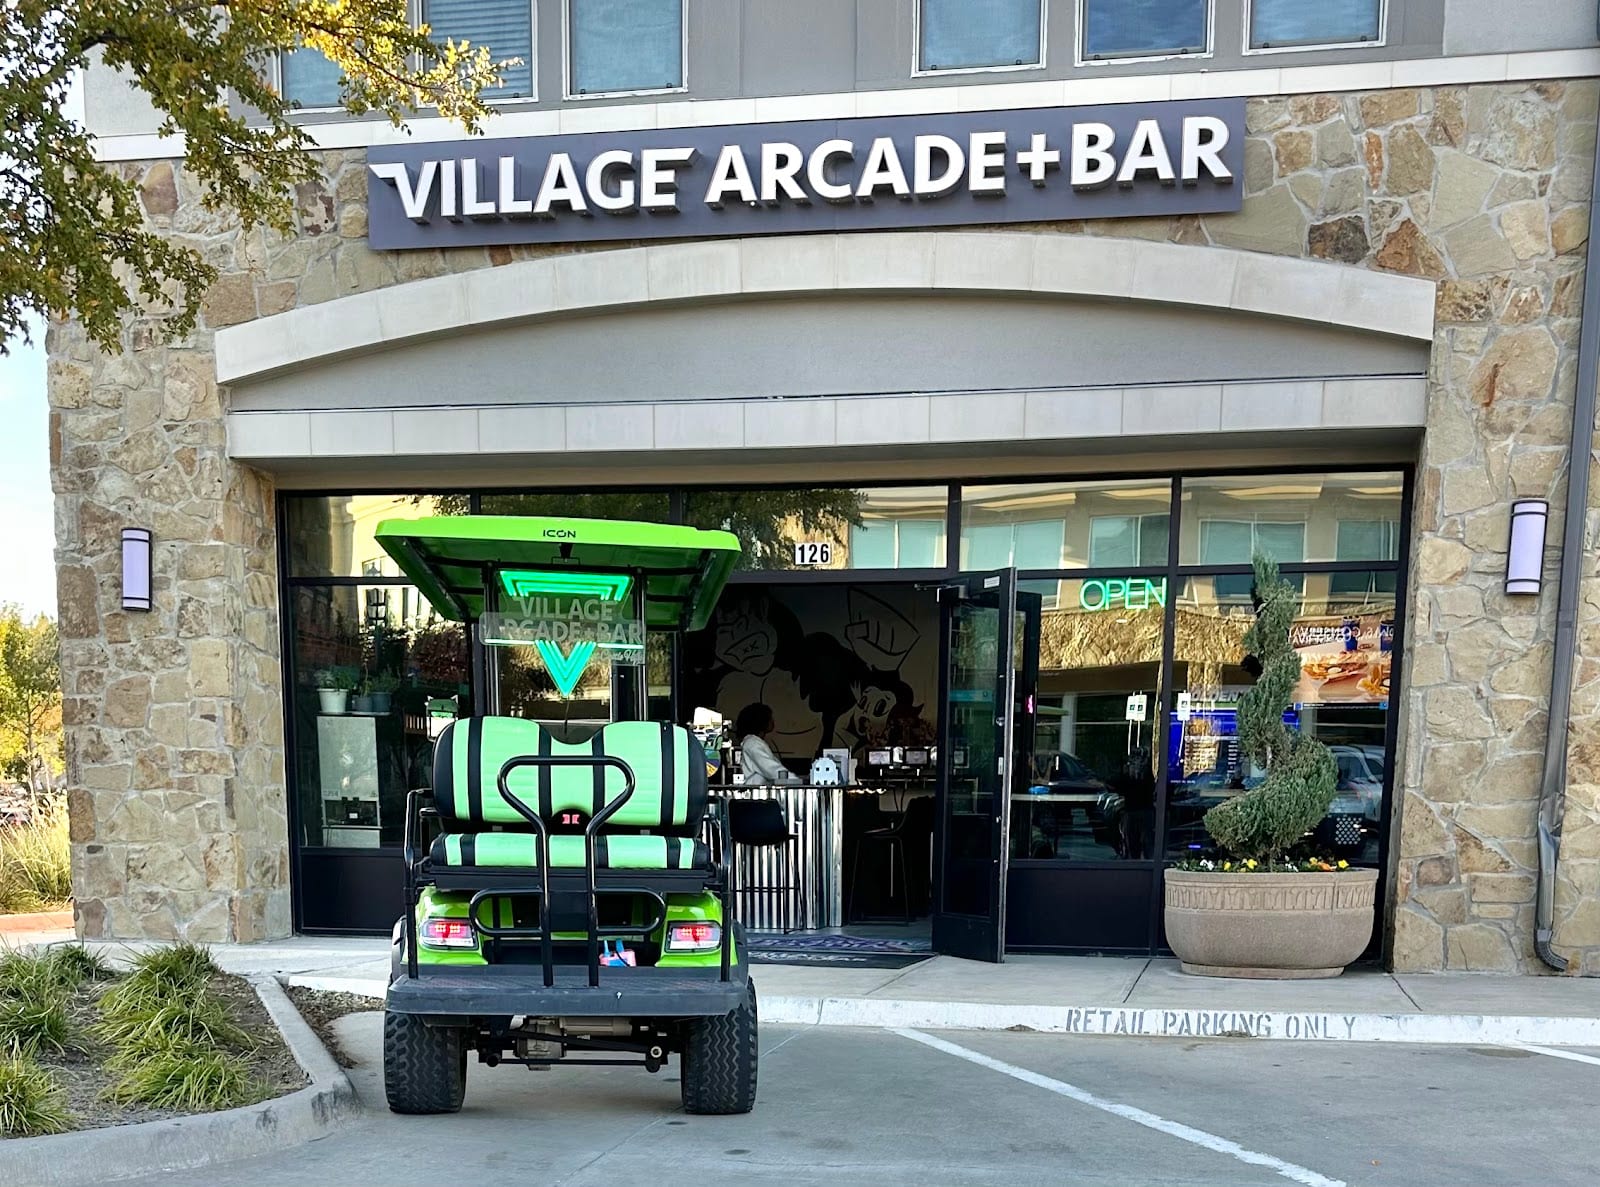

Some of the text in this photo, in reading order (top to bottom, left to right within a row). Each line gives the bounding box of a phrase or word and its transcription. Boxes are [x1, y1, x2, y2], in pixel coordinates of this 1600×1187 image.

[369, 147, 697, 220] VILLAGE
[543, 529, 577, 538] ICON
[798, 543, 829, 563] 126
[1080, 577, 1167, 610] OPEN
[513, 596, 618, 621] VILLAGE
[1065, 1008, 1356, 1039] RETAIL PARKING ONLY
